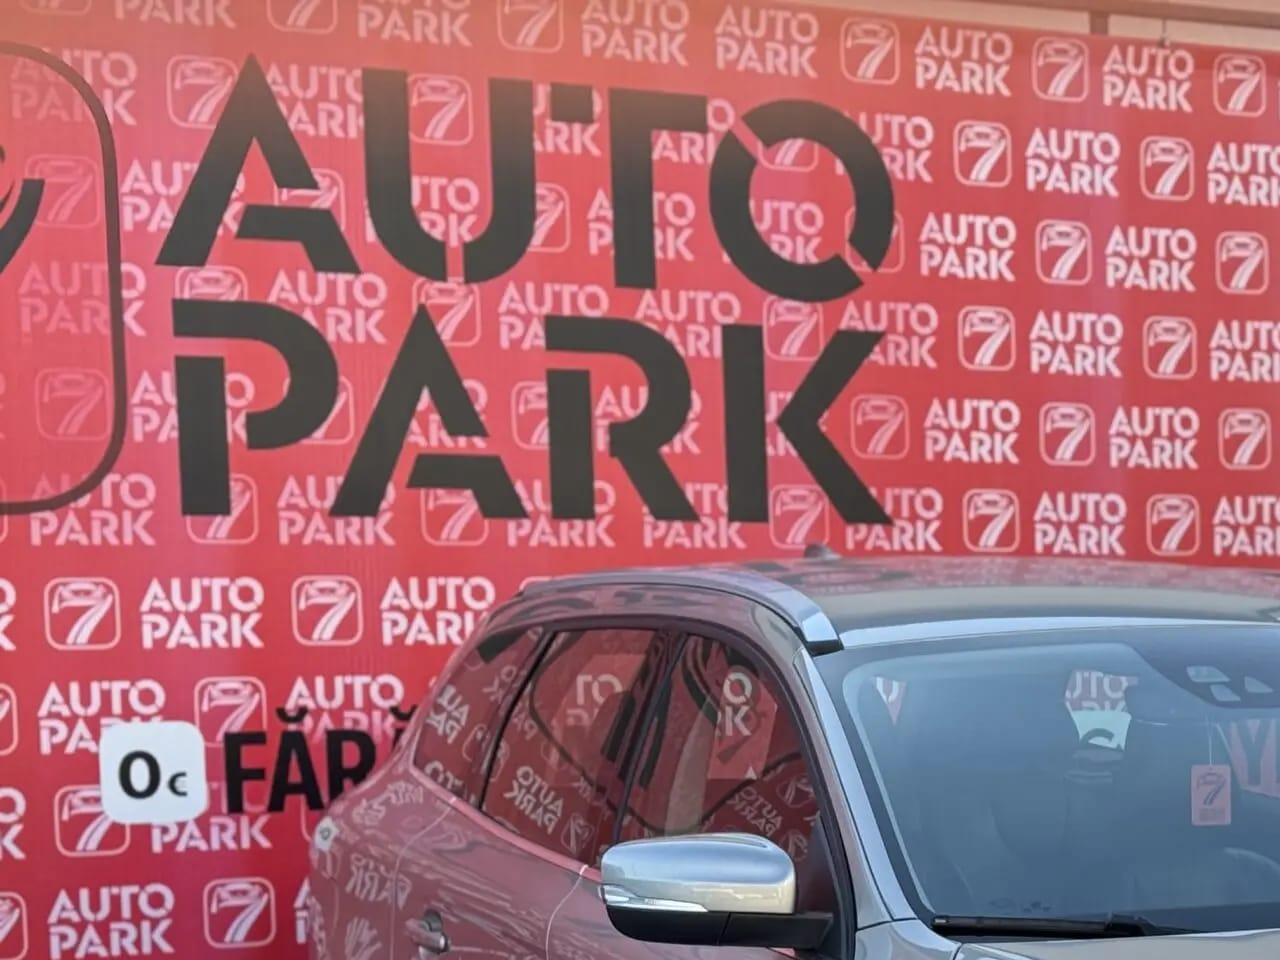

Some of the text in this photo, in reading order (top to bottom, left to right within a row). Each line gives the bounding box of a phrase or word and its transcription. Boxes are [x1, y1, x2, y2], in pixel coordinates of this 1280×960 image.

[359, 6, 471, 46] PARK
[582, 0, 688, 30] AUTO
[716, 9, 818, 48] AUTO
[584, 25, 686, 66] PARK
[717, 37, 815, 77] PARK
[915, 28, 1012, 65] AUTO
[916, 57, 1010, 96] PARK
[1103, 46, 1193, 83] AUTO
[1104, 75, 1191, 112] PARK
[1026, 128, 1120, 164] AUTO
[155, 52, 895, 302] AUTO
[1028, 155, 1118, 196] PARK
[921, 214, 1016, 248] AUTO
[1106, 226, 1196, 259] AUTO
[922, 239, 1014, 280] PARK
[1107, 257, 1194, 290] PARK
[268, 271, 387, 307] AUTO
[498, 282, 608, 316] AUTO
[635, 290, 740, 323] AUTO
[840, 301, 938, 334] AUTO
[1030, 312, 1122, 344] AUTO
[1032, 342, 1120, 376] PARK
[172, 298, 894, 525] PARK
[926, 399, 1020, 431] AUTO
[1109, 407, 1199, 438] AUTO
[927, 430, 1018, 463] PARK
[1110, 437, 1196, 468] PARK
[1034, 493, 1126, 524] AUTO
[31, 510, 154, 545] PARK
[280, 511, 394, 545] PARK
[508, 515, 614, 546] PARK
[644, 515, 746, 548] PARK
[847, 520, 941, 551] PARK
[1036, 524, 1124, 554] PARK
[141, 578, 264, 612] AUTO
[381, 577, 494, 610] AUTO
[142, 614, 262, 648] PARK
[38, 680, 165, 716] AUTO
[286, 674, 404, 709] AUTO
[223, 704, 417, 814] FĂR
[152, 815, 272, 853] PARK
[48, 884, 174, 923] AUTO
[50, 919, 173, 960] PARK
